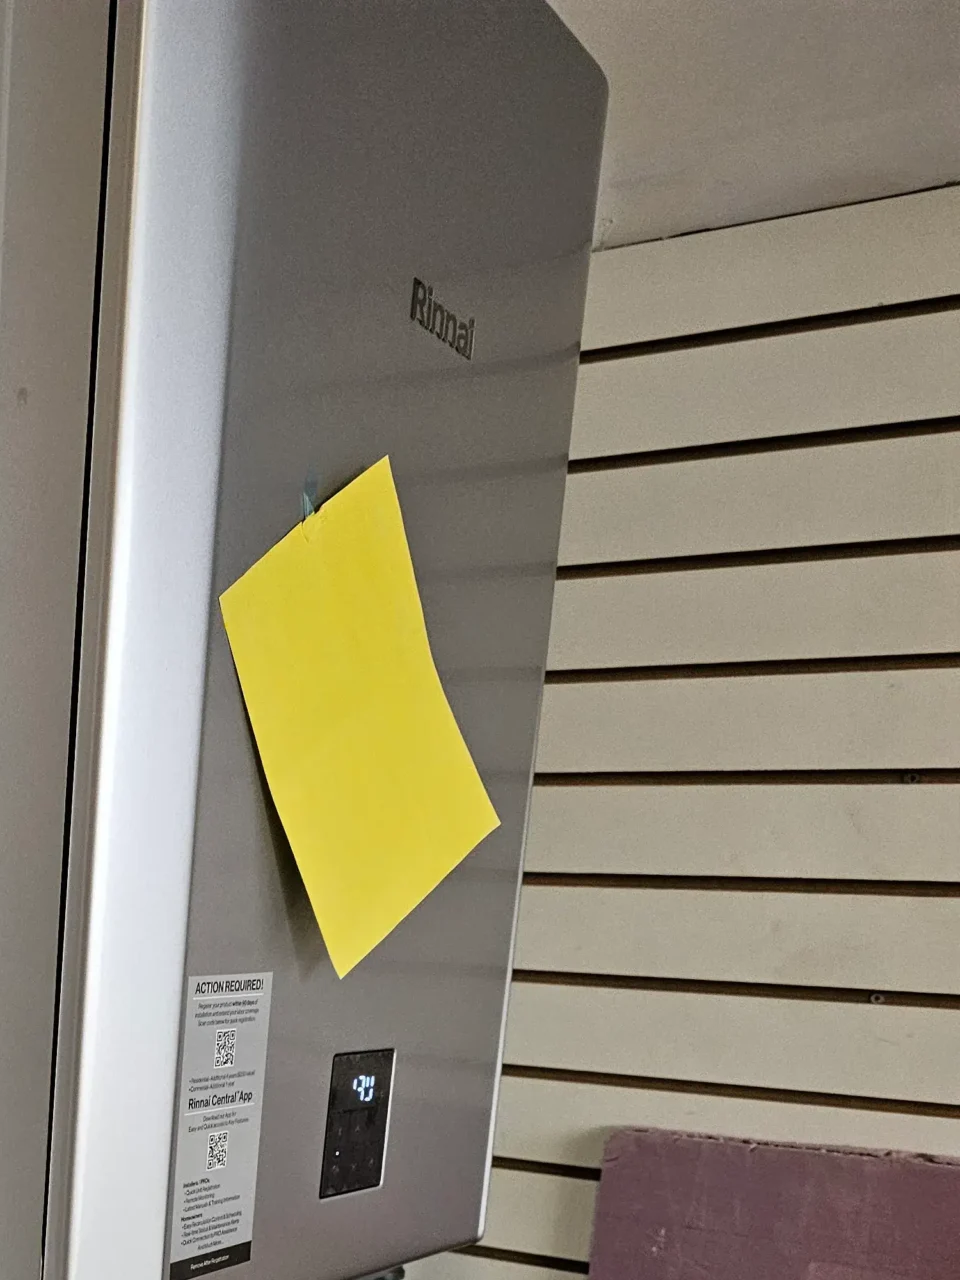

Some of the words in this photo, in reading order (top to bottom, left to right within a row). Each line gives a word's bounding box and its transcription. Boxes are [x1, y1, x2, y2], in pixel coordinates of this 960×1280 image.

[410, 277, 475, 360] Rinnai
[195, 980, 224, 995] ACTION
[224, 979, 264, 992] REQUIRED!
[188, 1095, 211, 1110] Rinnai
[238, 1090, 253, 1104] App
